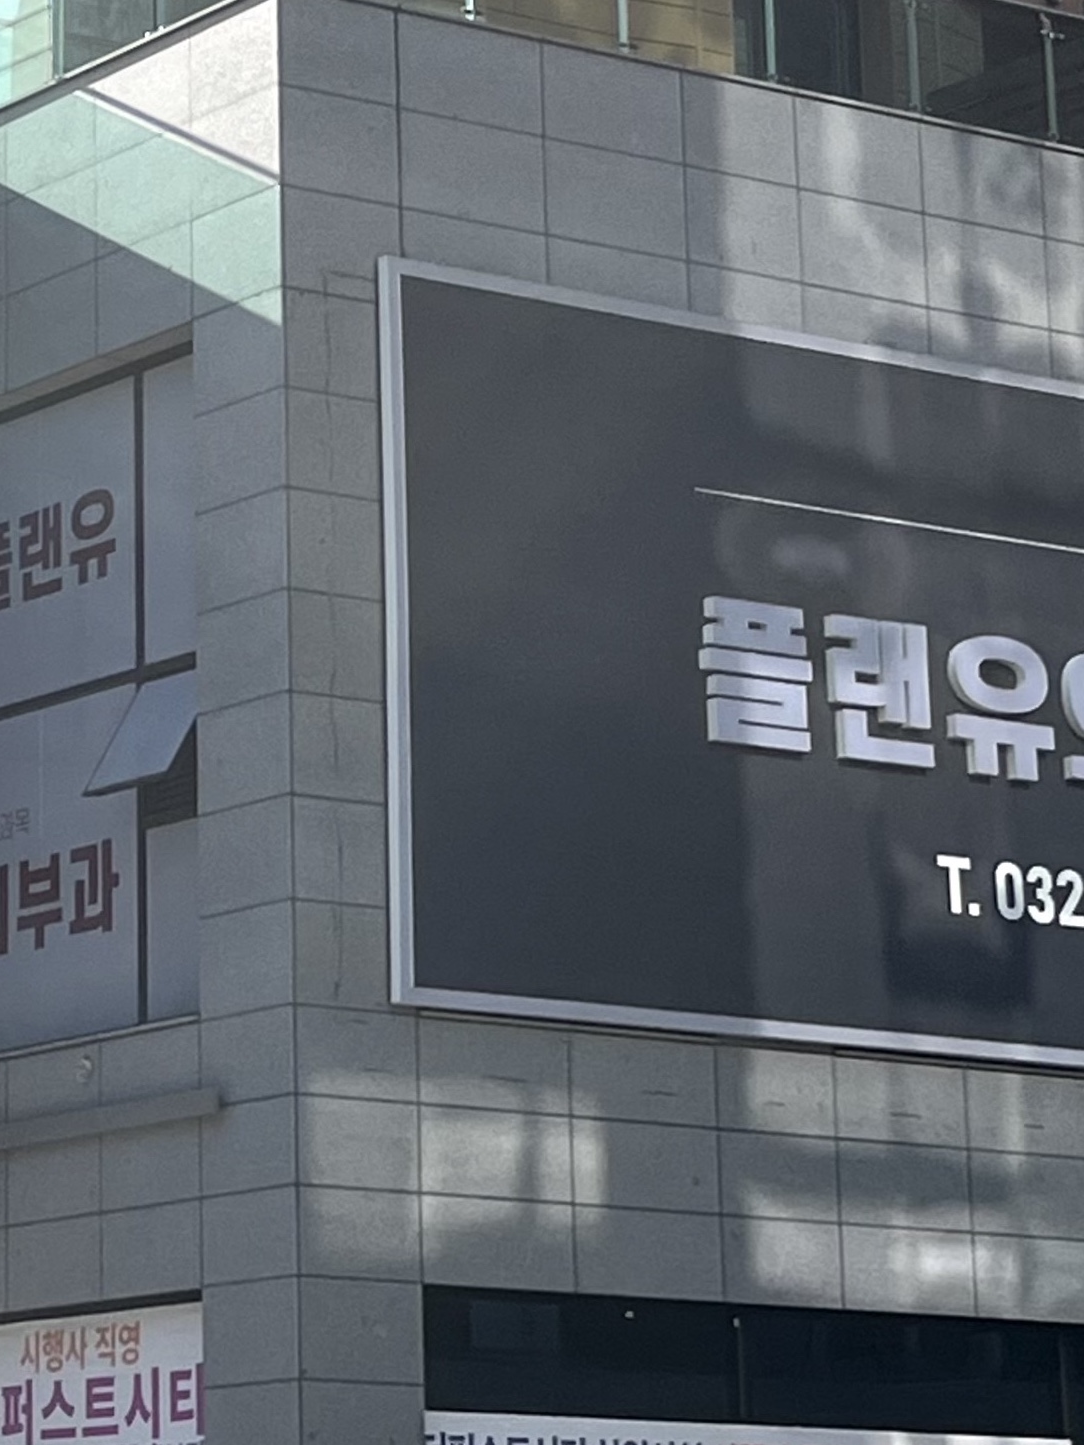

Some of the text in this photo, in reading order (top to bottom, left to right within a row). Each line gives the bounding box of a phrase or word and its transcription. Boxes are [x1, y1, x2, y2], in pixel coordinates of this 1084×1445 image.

[698, 595, 1084, 782] 플랜유
[935, 853, 981, 917] T.
[20, 1320, 142, 1374] 시행사 직영
